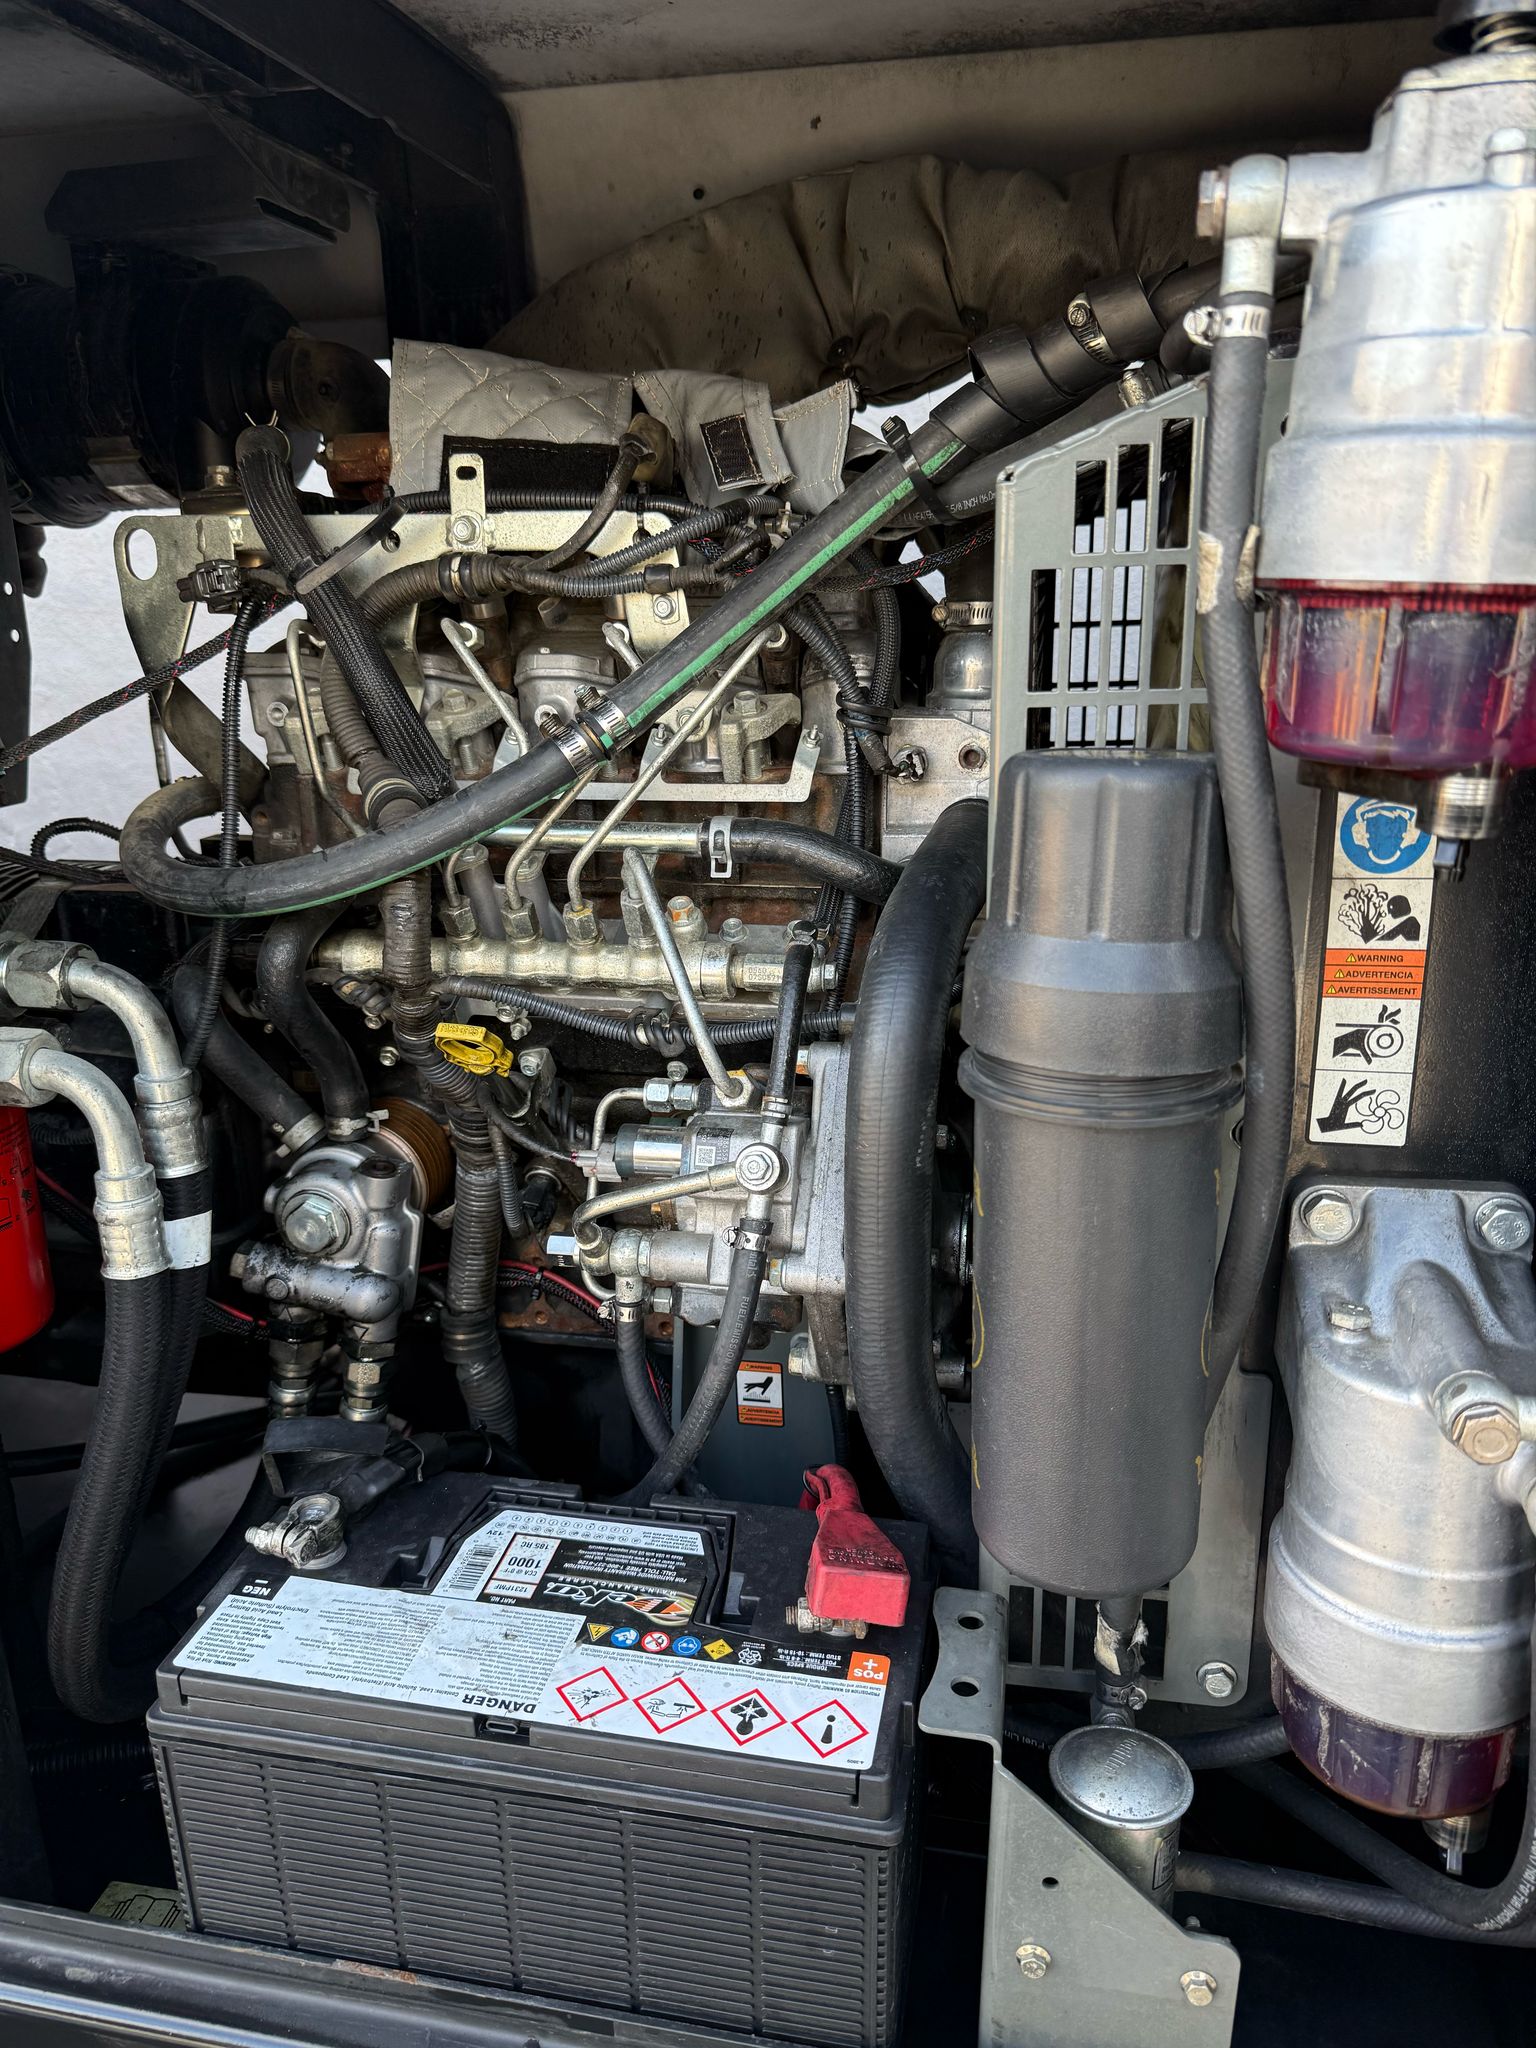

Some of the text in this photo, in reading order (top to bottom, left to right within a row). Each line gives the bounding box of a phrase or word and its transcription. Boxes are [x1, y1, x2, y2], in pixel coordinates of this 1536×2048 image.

[961, 496, 979, 509] INCH
[1357, 953, 1403, 963] WARNING
[1345, 969, 1413, 979] ADVERTENCIA
[1337, 985, 1416, 996] AVERTISSEMENT
[724, 1296, 749, 1363] FUEL/EMISSION
[485, 1528, 502, 1536] 12V
[534, 1542, 549, 1550] 185
[507, 1555, 542, 1569] 1000
[562, 1561, 603, 1572] INFORMATION
[603, 1566, 636, 1576] WARRANTY
[625, 1564, 642, 1572] FREE
[637, 1571, 675, 1581] NATIONWIDE
[241, 1583, 271, 1596] NEG
[493, 1583, 528, 1592] 1231PMF
[229, 1596, 248, 1605] Acid)
[227, 1602, 283, 1616] Lead Acid Battery
[275, 1603, 309, 1614] Electrolyte
[826, 1653, 841, 1661] STUD
[785, 1659, 827, 1671] TORQUE SPECS.
[852, 1667, 884, 1679] POS
[434, 1688, 459, 1697] Contains:
[461, 1693, 536, 1714] DANGER
